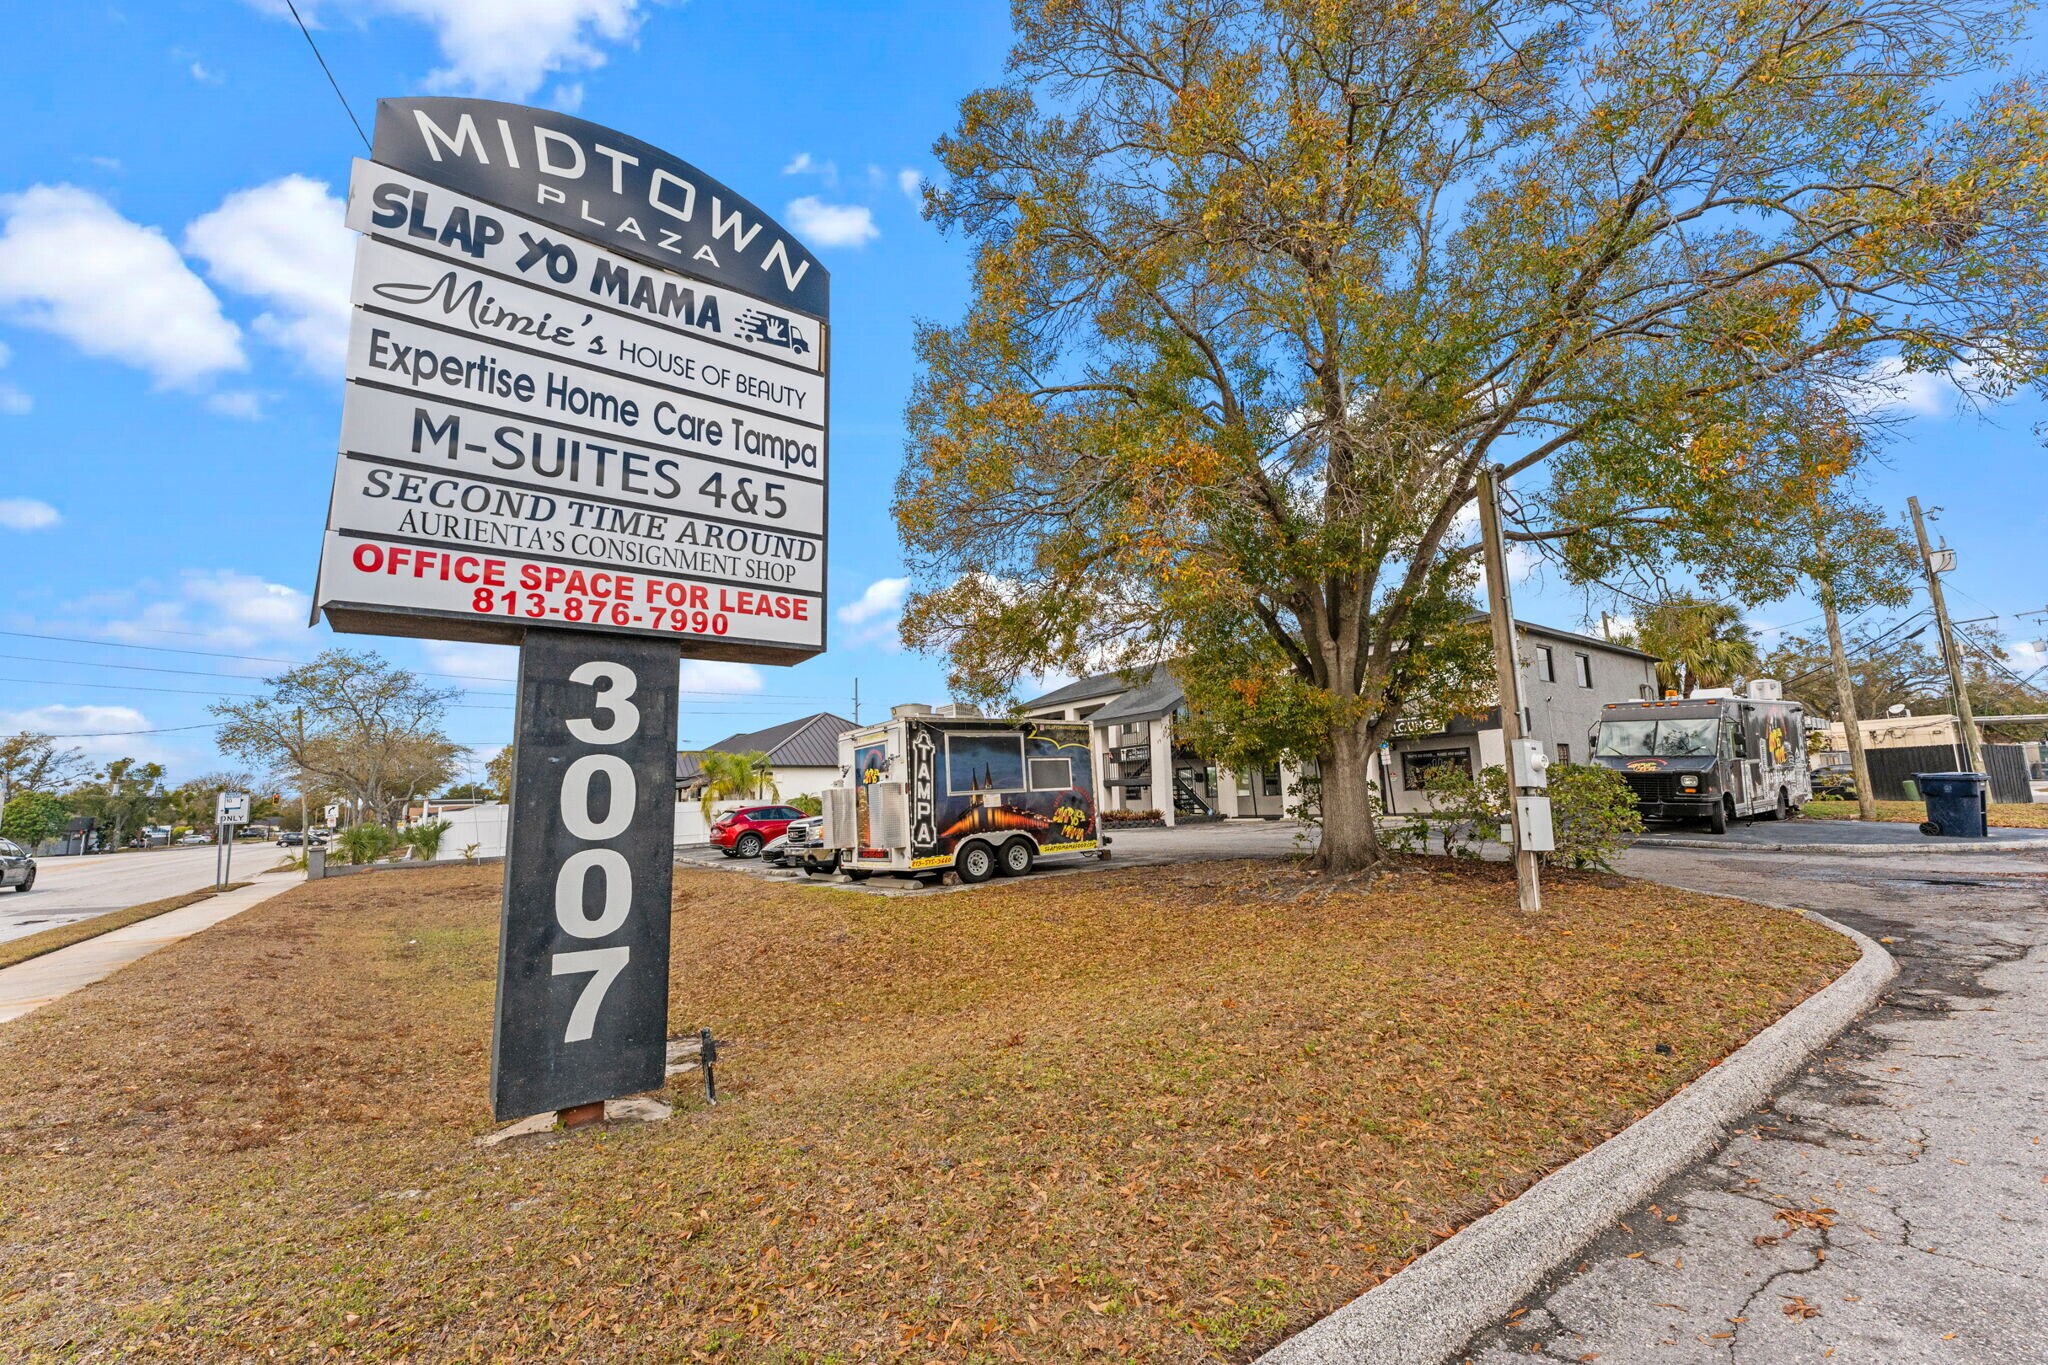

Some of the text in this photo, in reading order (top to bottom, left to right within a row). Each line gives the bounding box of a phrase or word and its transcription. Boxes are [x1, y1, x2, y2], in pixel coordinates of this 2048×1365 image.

[413, 109, 811, 293] MIDTOWN
[536, 183, 721, 269] PLAZA
[371, 182, 722, 334] SLAP YO MAMA
[373, 271, 808, 410] Mimie's HOUSE OF BEAUTY
[368, 328, 818, 470] Expertise Home Care Tampa
[410, 406, 788, 519] M-SUITES 4&5
[362, 468, 818, 564] SECOND TIME AROUND
[398, 507, 797, 584] AURIENTA'S CONSIGNMENT SHOP
[351, 542, 809, 622] OFFICE SPACE FOR LEASE
[472, 587, 730, 636] 813-876-7990
[917, 743, 931, 843] TAMPA
[551, 661, 641, 1043] 3007
